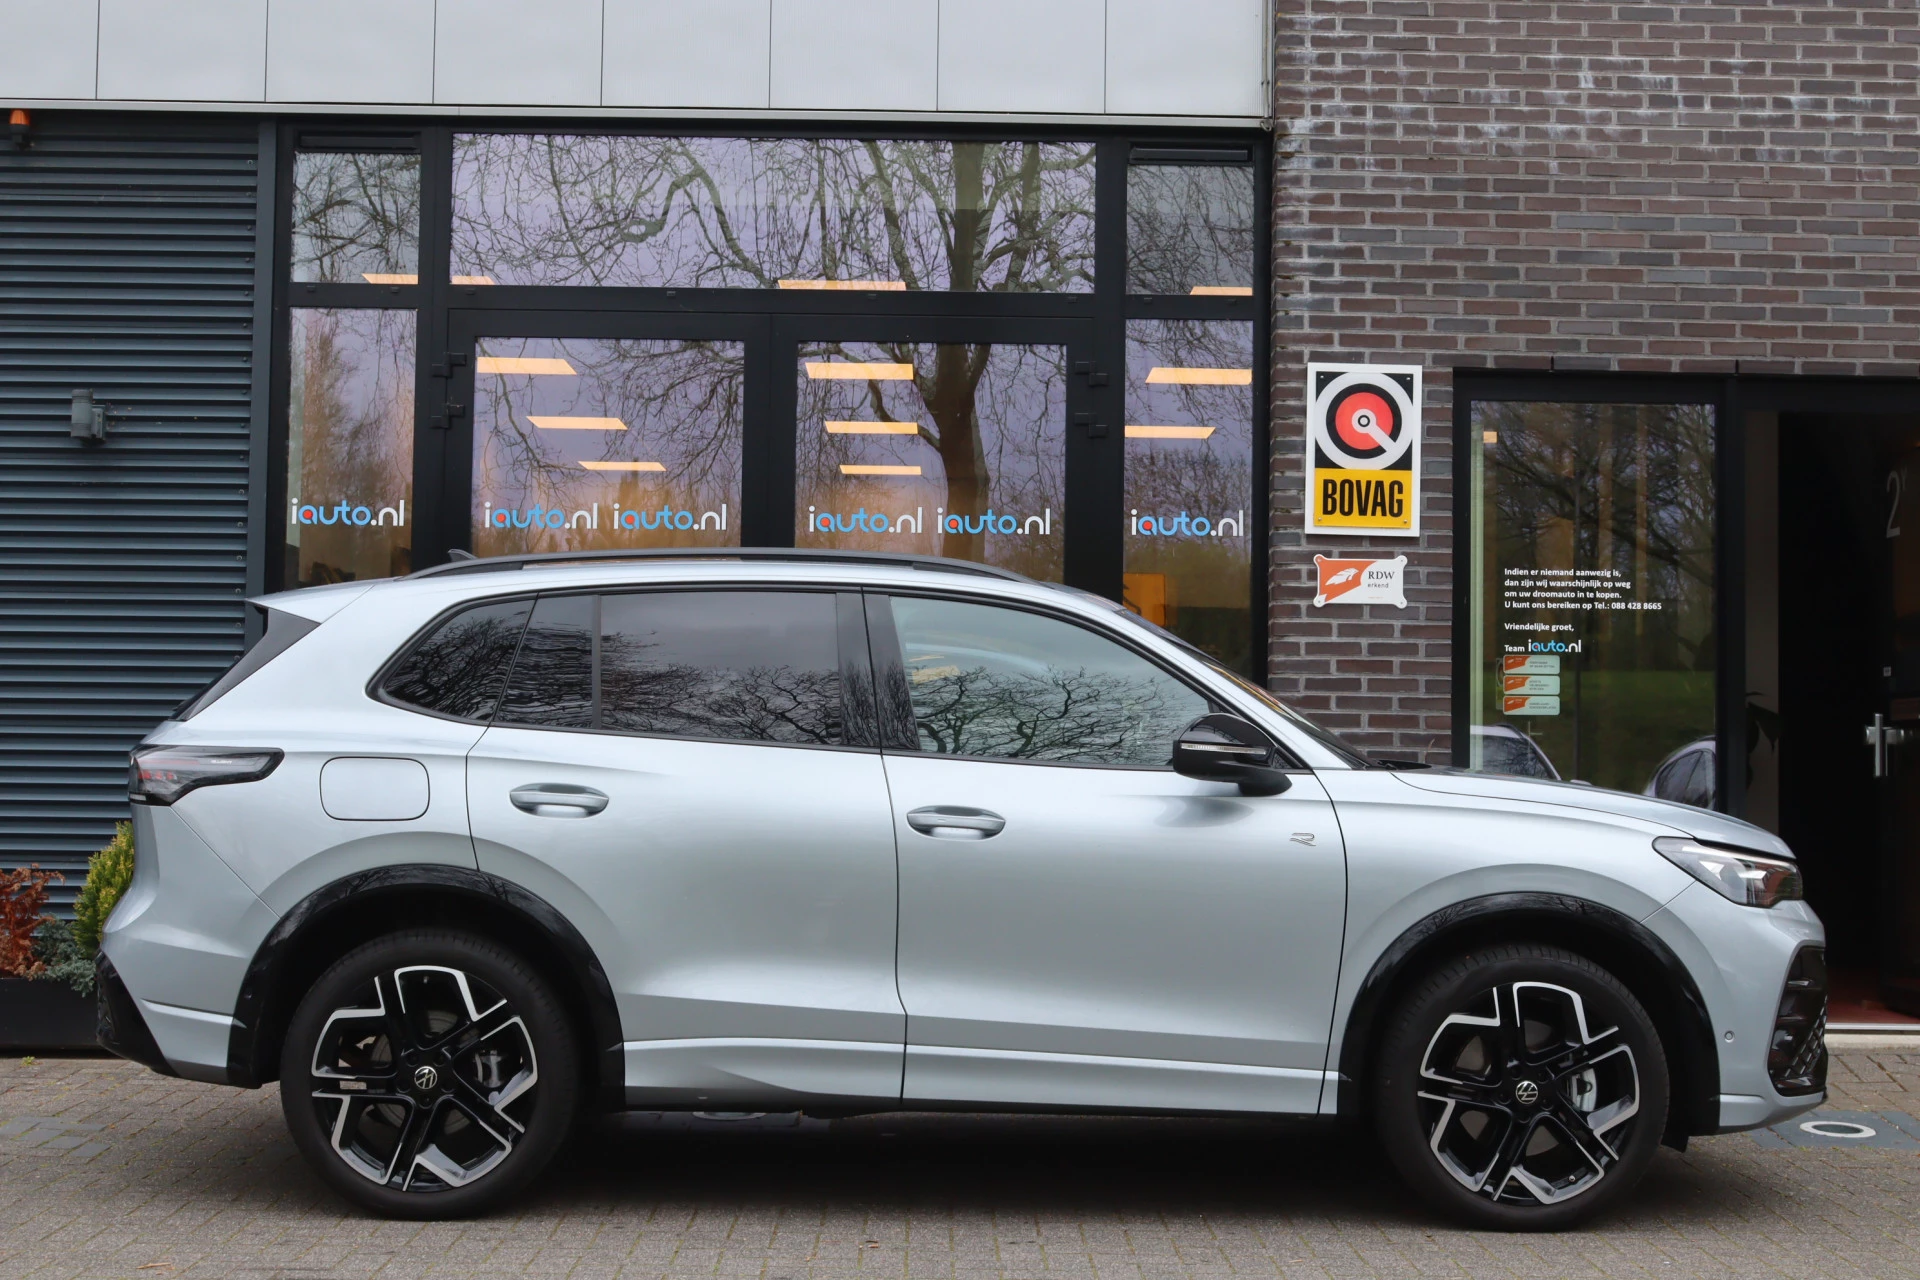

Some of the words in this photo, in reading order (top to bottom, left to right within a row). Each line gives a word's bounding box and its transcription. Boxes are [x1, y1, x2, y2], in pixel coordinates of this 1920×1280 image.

[1322, 479, 1404, 518] BOVAG
[291, 497, 405, 527] iauto.nl
[484, 501, 597, 530] iauto.nl
[613, 502, 727, 531] iauto.nl
[808, 505, 922, 533] iauto.nl
[937, 507, 1051, 535] iauto.nl
[1131, 508, 1244, 537] iauto.nl
[1367, 570, 1395, 580] RDW
[1504, 568, 1529, 576] Indien
[1540, 568, 1574, 576] niemand
[1575, 569, 1611, 578] aanwezig
[1612, 569, 1622, 577] is,
[1504, 579, 1519, 587] dan
[1520, 579, 1535, 588] zijn
[1535, 579, 1548, 588] wij
[1549, 580, 1601, 589] waarschijnlijk
[1602, 581, 1614, 589] op
[1614, 581, 1631, 589] weg
[1532, 589, 1576, 598] droomauto
[1577, 590, 1585, 598] in
[1595, 590, 1622, 600] kopen.
[1504, 601, 1511, 609] U
[1512, 601, 1530, 609] kunt
[1547, 601, 1581, 609] bereiken
[1582, 602, 1593, 610] op
[1593, 601, 1610, 609] Tel.:
[1611, 602, 1626, 610] 088
[1627, 602, 1642, 610] 428
[1643, 602, 1662, 610] 8665
[1504, 622, 1550, 632] Vriendelijke
[1551, 624, 1575, 632] groet,
[1504, 644, 1526, 652] Team
[1528, 638, 1582, 652] iauto.nl
